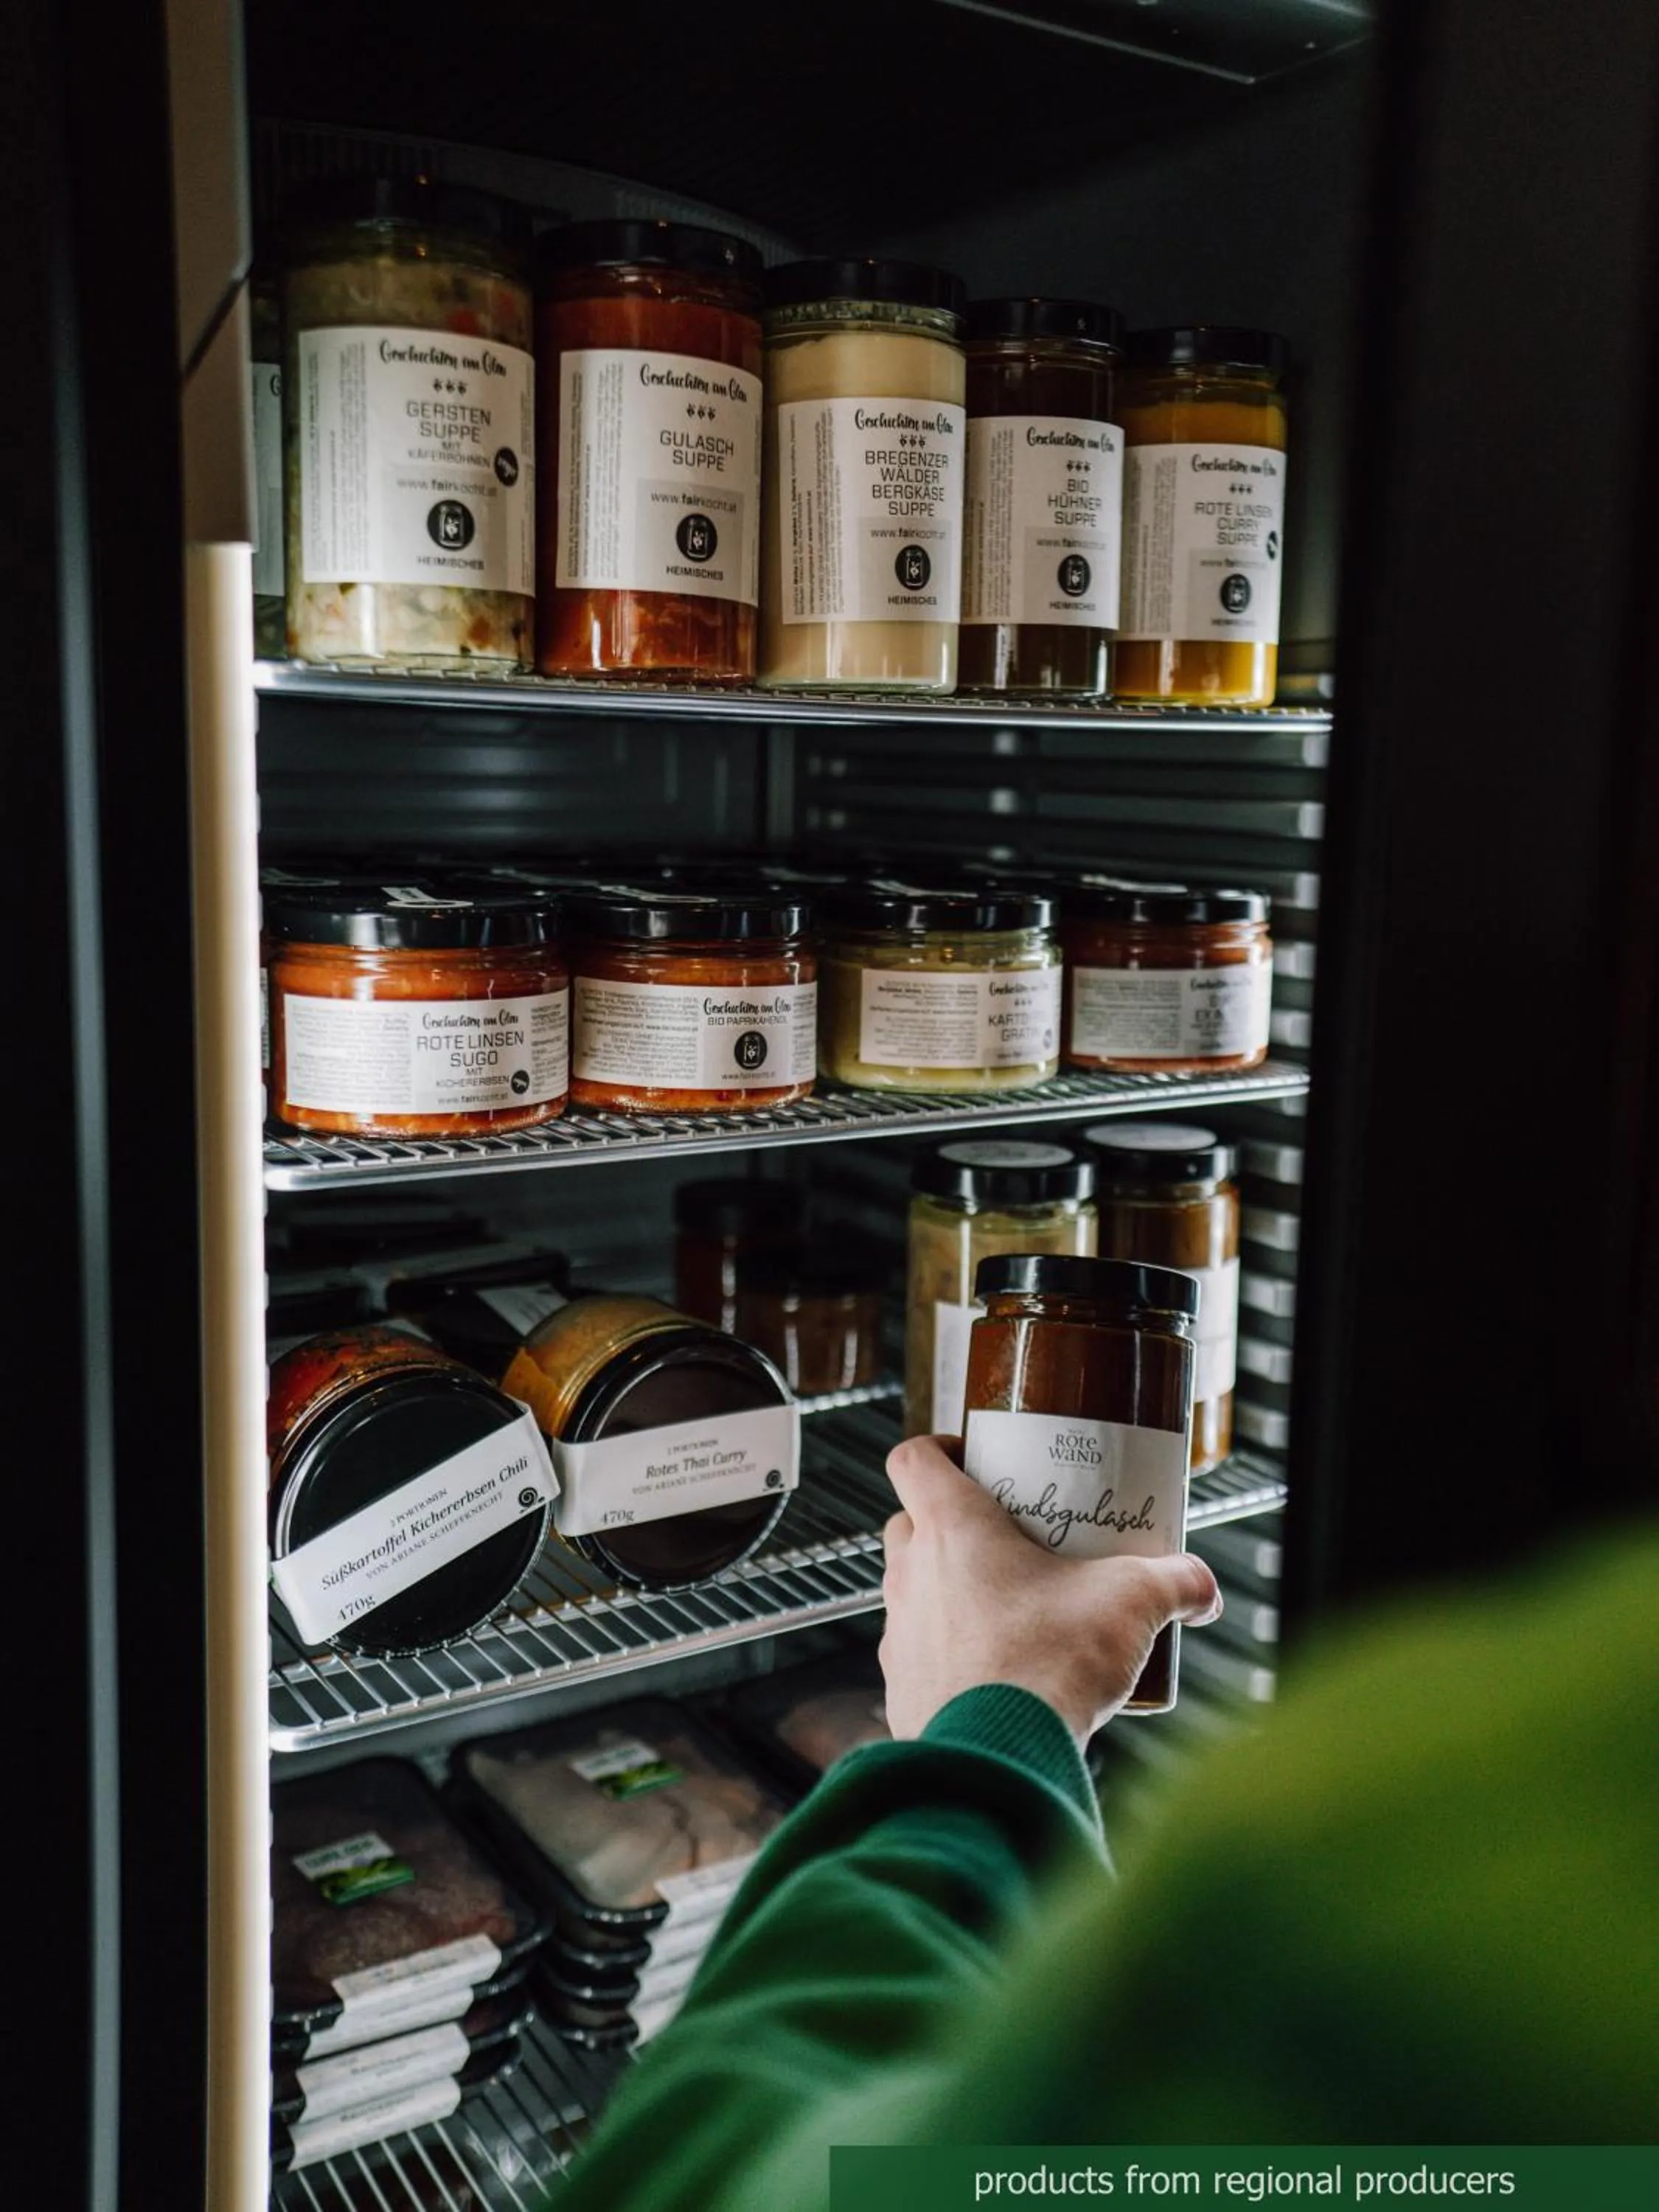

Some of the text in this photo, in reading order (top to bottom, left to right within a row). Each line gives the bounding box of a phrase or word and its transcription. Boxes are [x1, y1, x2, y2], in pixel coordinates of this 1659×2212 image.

[406, 400, 492, 427] GERSTEN
[420, 421, 481, 444] SUPPE
[660, 430, 734, 457] GULASCH
[672, 449, 725, 472] SUPPE
[865, 450, 949, 469] BREGENZER
[880, 464, 940, 484] WÄLDER
[872, 481, 945, 502] BERGKÄSE
[1067, 479, 1089, 493] BIO
[888, 501, 935, 517] SUPPE
[1048, 491, 1102, 511] HÜHNER
[1194, 502, 1233, 515] ROTE
[1054, 511, 1097, 527] SUPPE
[708, 1017, 725, 1026] BIO
[417, 1031, 524, 1051] ROTE LINSEN
[450, 1050, 498, 1067] SUGO
[645, 1449, 748, 1479] Rotes Thai Curry
[410, 1478, 496, 1537] Kichererbsen
[498, 1455, 529, 1483] Chili
[599, 1509, 636, 1525] 470g
[991, 1477, 1155, 1548] Rindsgulasch
[366, 1562, 389, 1580] VON
[390, 1538, 428, 1566] ARIANE
